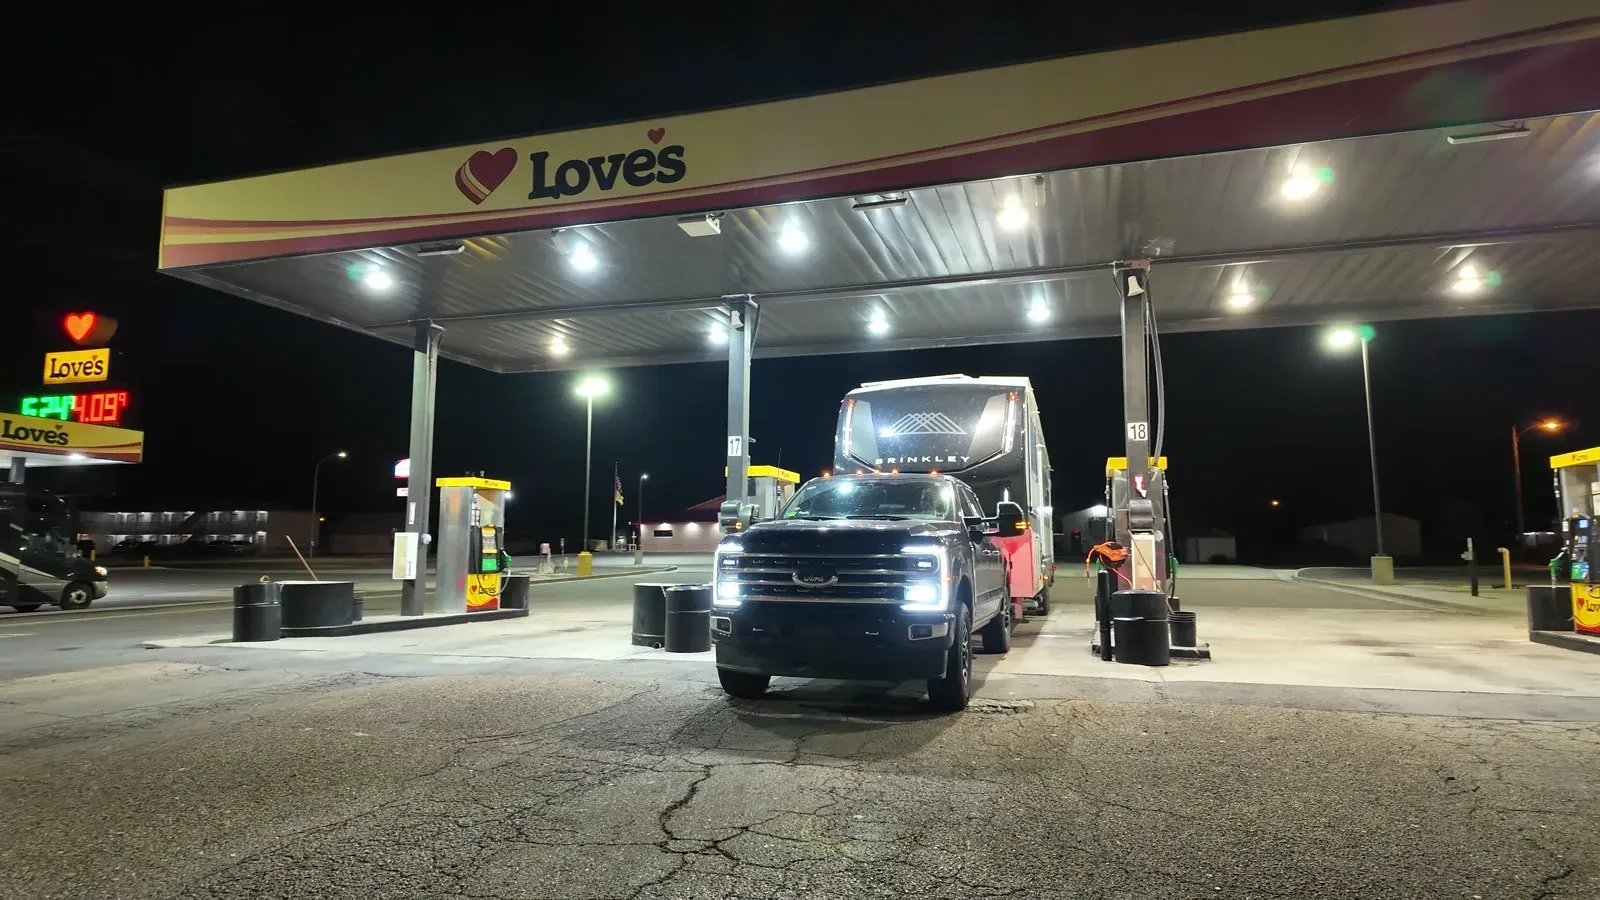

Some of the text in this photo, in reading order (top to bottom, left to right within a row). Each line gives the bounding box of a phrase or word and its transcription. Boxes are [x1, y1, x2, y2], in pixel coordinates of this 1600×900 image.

[528, 128, 687, 200] Love's
[49, 355, 104, 379] Love's
[1, 419, 69, 445] Love's
[1130, 423, 1146, 440] 18
[730, 437, 741, 455] 17
[875, 456, 971, 465] BRINKLEY
